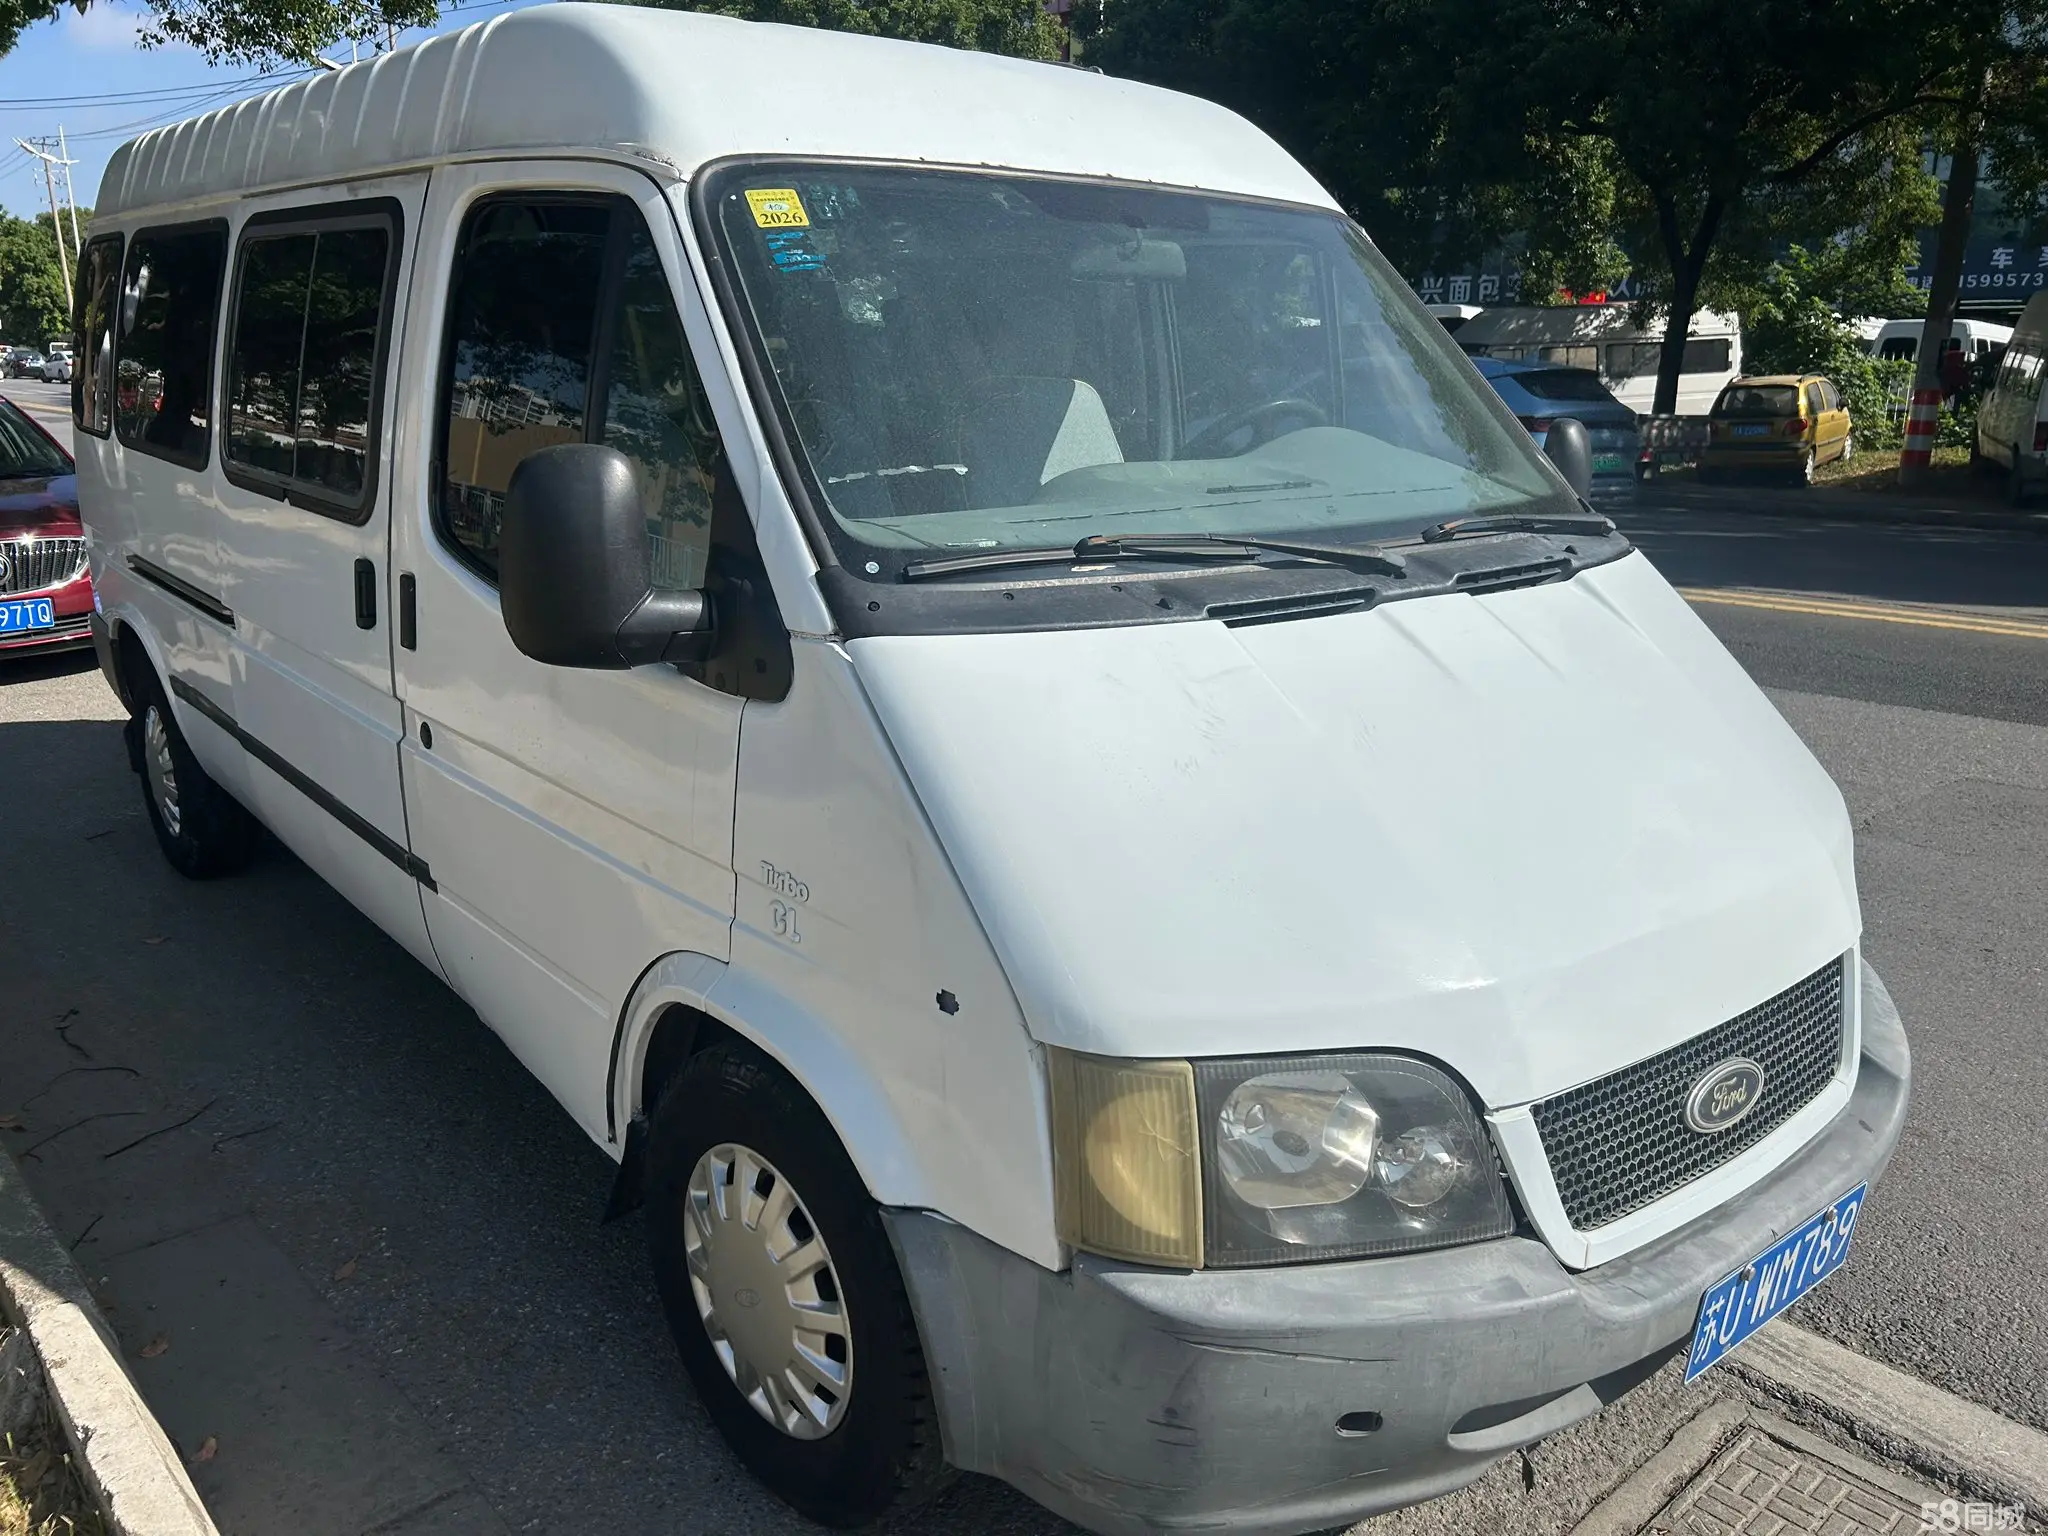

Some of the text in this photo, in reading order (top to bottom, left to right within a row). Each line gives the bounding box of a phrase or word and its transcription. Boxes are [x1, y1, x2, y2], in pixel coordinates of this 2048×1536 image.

[760, 212, 803, 225] 2026
[1958, 272, 2044, 288] 1599573
[760, 860, 810, 903] Turbo
[1712, 1076, 1748, 1117] Ford
